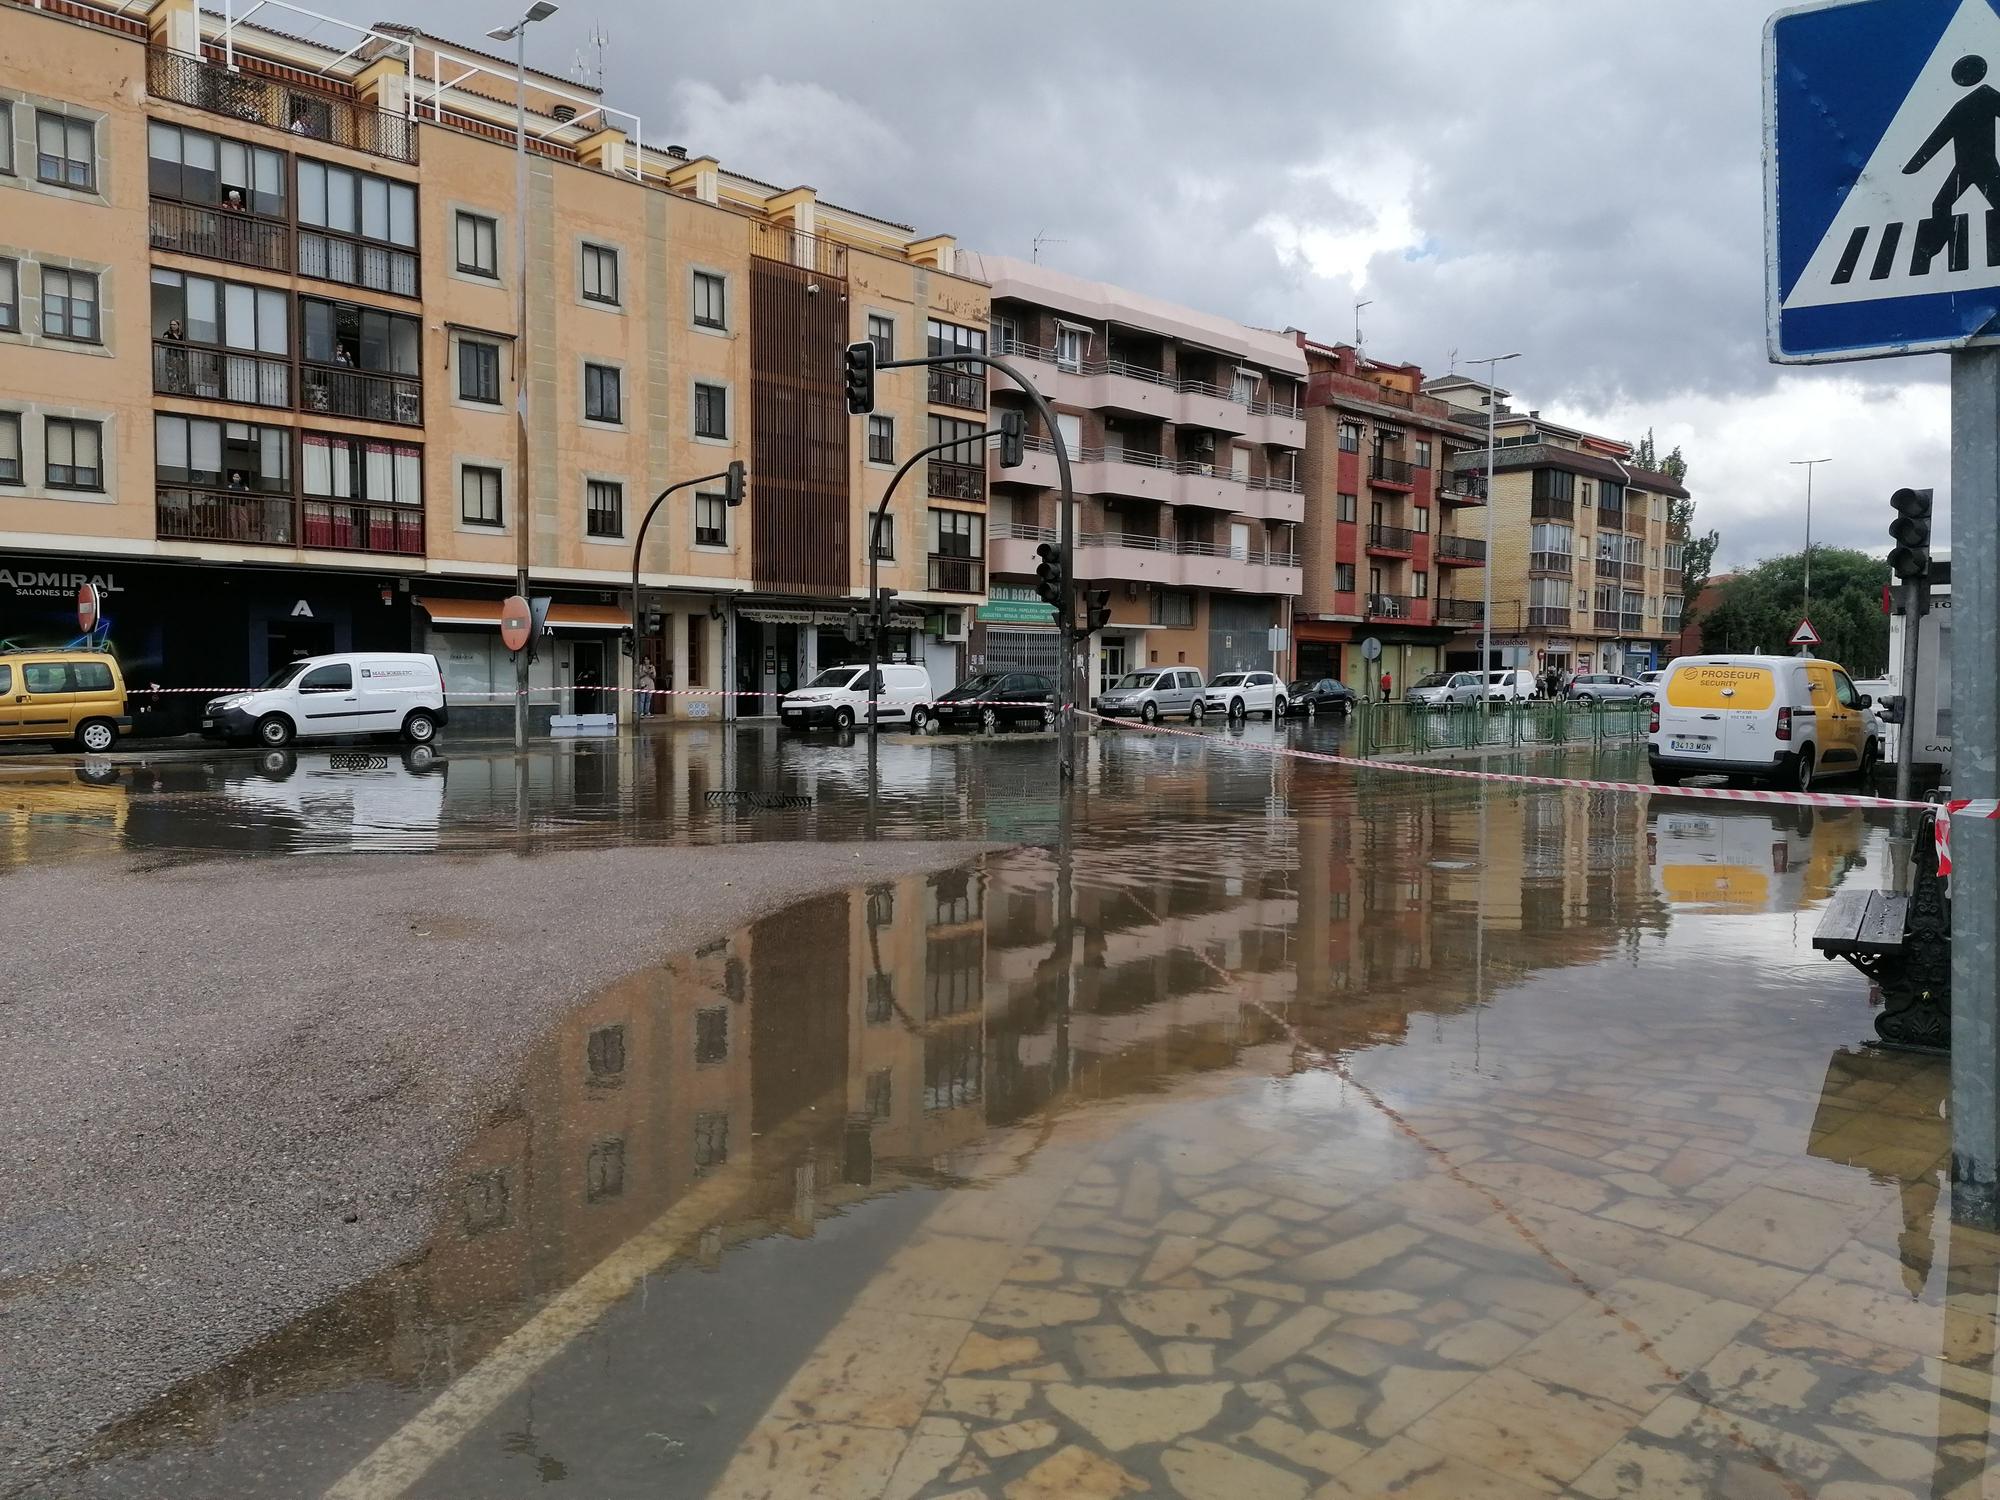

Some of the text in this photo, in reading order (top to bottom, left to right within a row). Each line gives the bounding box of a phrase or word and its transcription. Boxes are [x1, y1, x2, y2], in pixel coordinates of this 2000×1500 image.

[0, 569, 124, 591] ADMIRAL
[16, 588, 60, 597] SALONES
[62, 589, 75, 597] DE
[989, 587, 1009, 600] RAN
[290, 599, 314, 617] A
[1701, 670, 1760, 680] PROSEGUR
